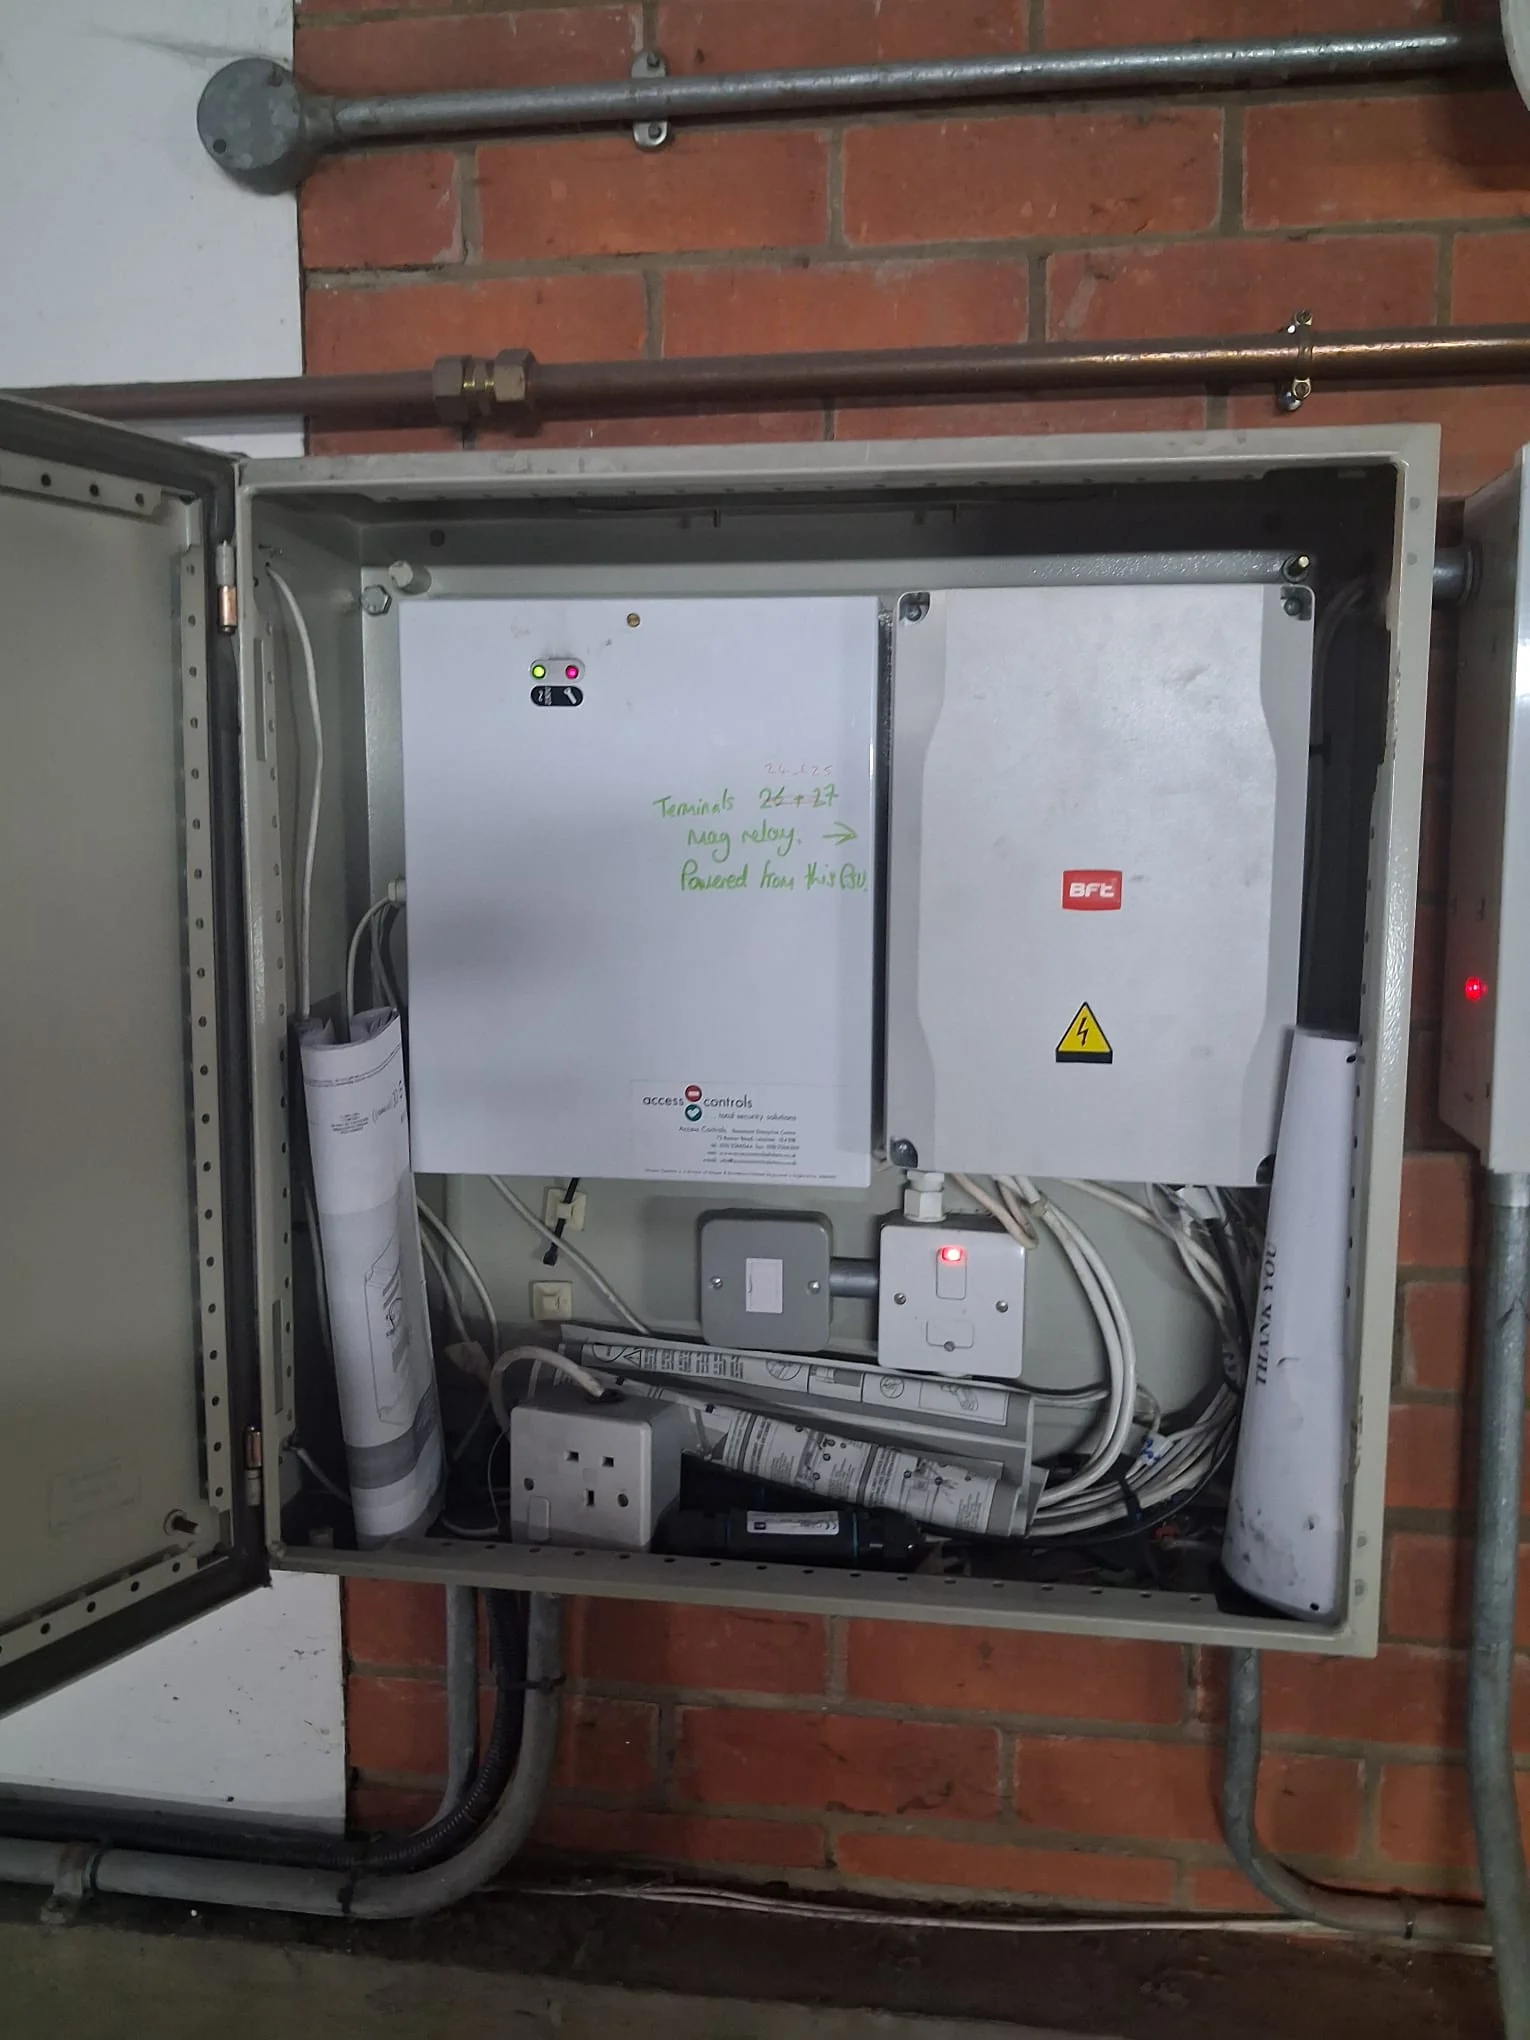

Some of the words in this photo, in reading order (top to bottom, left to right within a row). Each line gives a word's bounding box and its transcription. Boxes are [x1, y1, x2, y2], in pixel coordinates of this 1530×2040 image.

[653, 787, 735, 818] Terminals
[680, 858, 749, 892] Powered
[759, 859, 795, 891] from
[642, 1095, 685, 1107] access
[703, 1094, 753, 1109] controls
[1263, 1241, 1278, 1292] YOU
[1255, 1303, 1273, 1386] THANK
